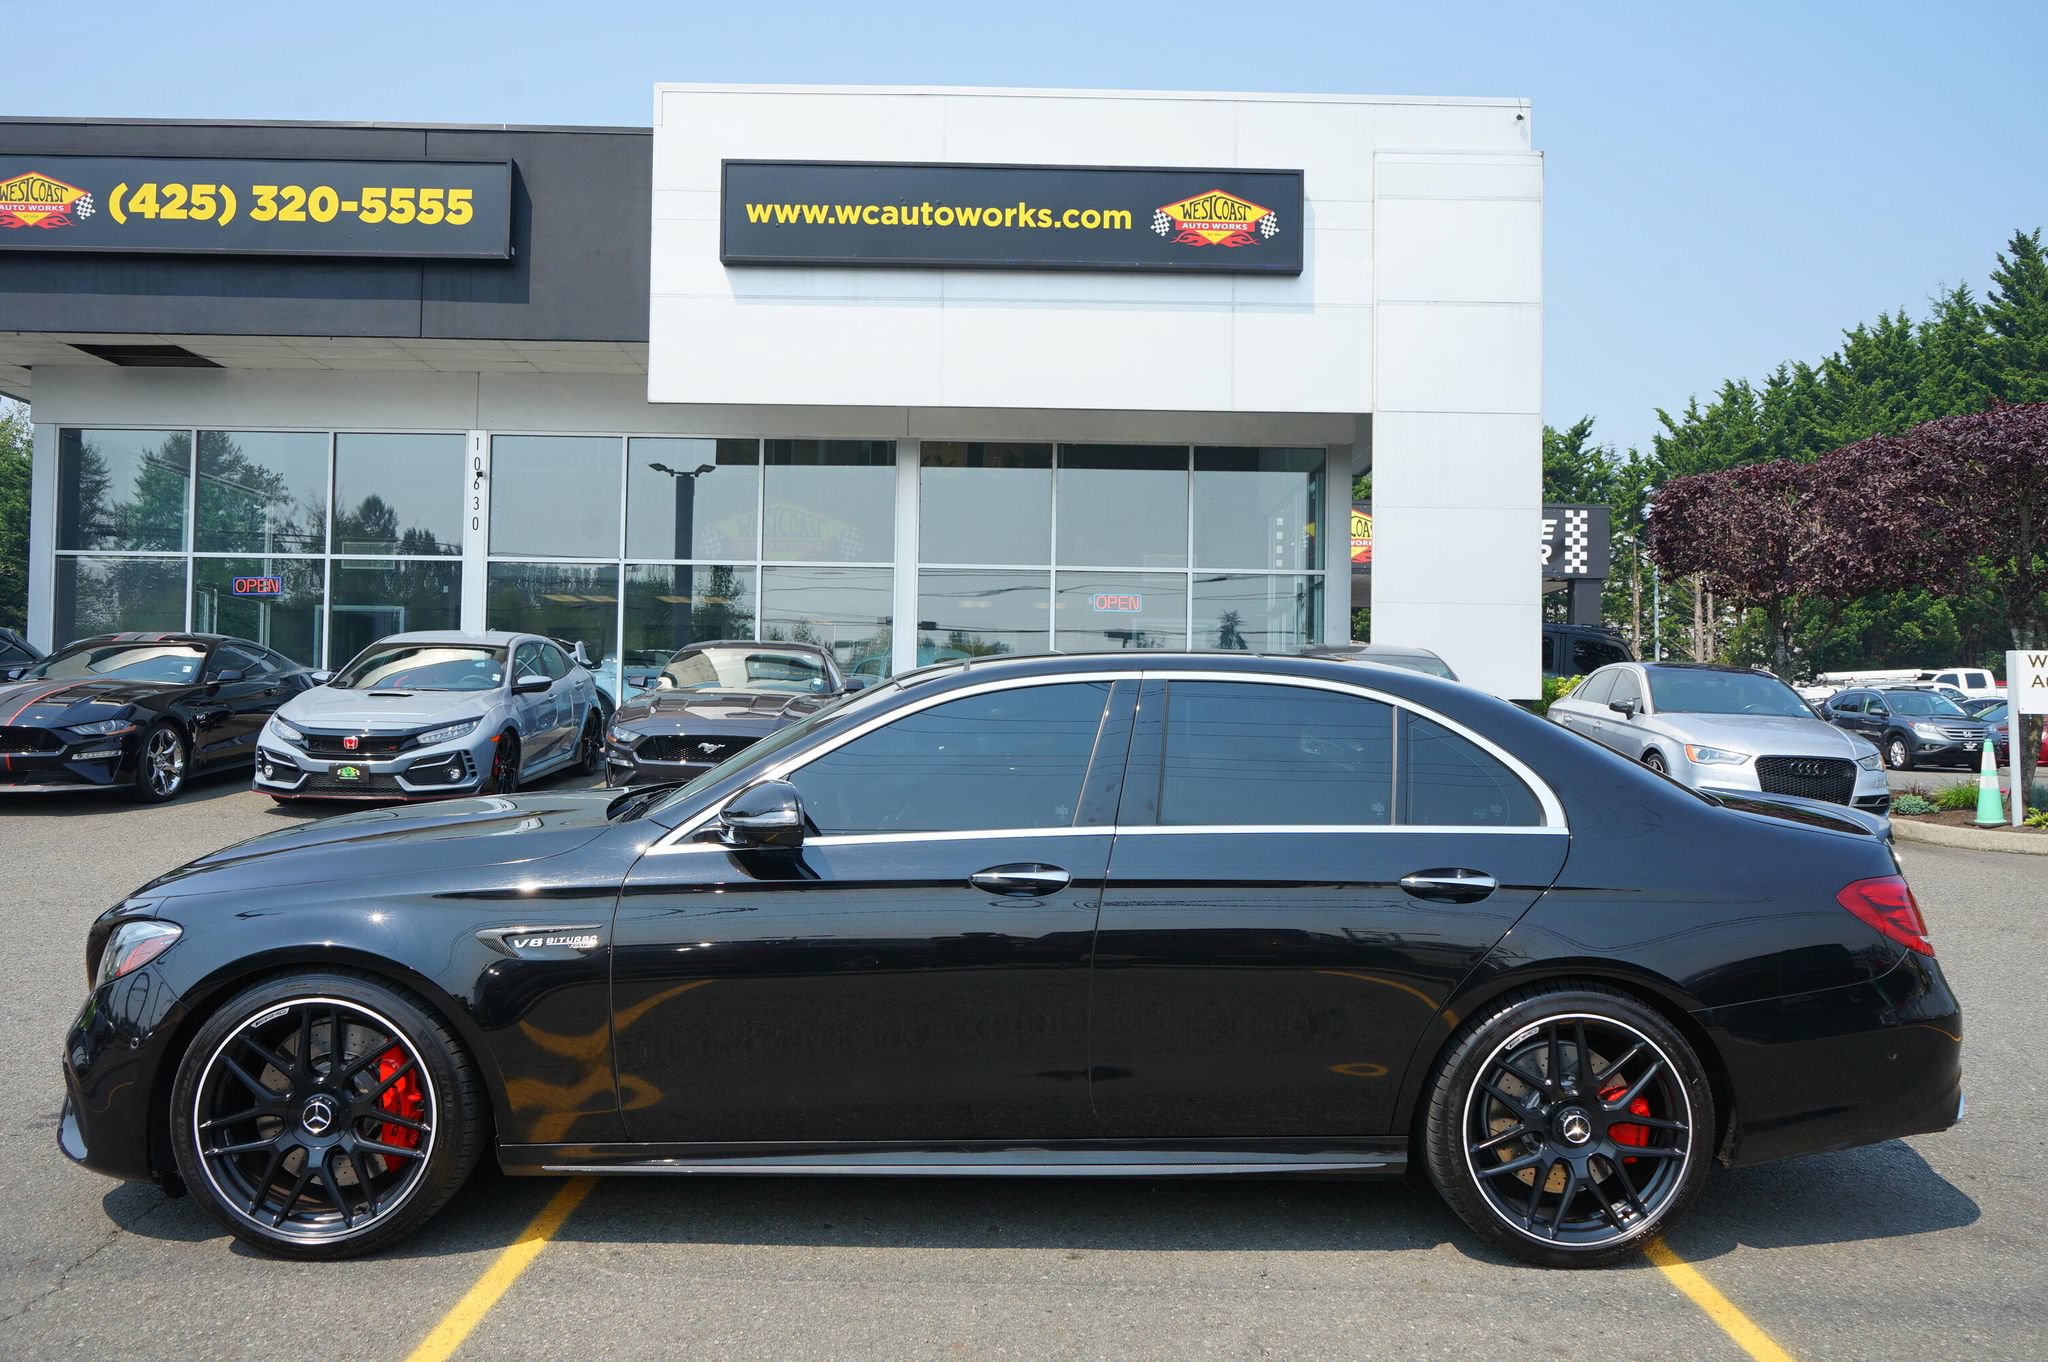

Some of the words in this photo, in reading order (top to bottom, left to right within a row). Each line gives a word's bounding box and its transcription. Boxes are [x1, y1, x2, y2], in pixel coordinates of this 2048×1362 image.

[0, 203, 25, 211] AUTO
[28, 204, 65, 212] WORKS
[108, 182, 237, 227] (425)
[249, 185, 474, 226] 320-5555
[745, 202, 1132, 230] www.wcautoworks.com
[1181, 222, 1209, 230] AUTO
[1212, 222, 1248, 231] WORKS
[235, 578, 279, 593] OPEN
[1096, 595, 1140, 610] OPEN
[2032, 675, 2048, 688] A
[514, 938, 543, 948] V8
[546, 935, 597, 944] BITURBO
